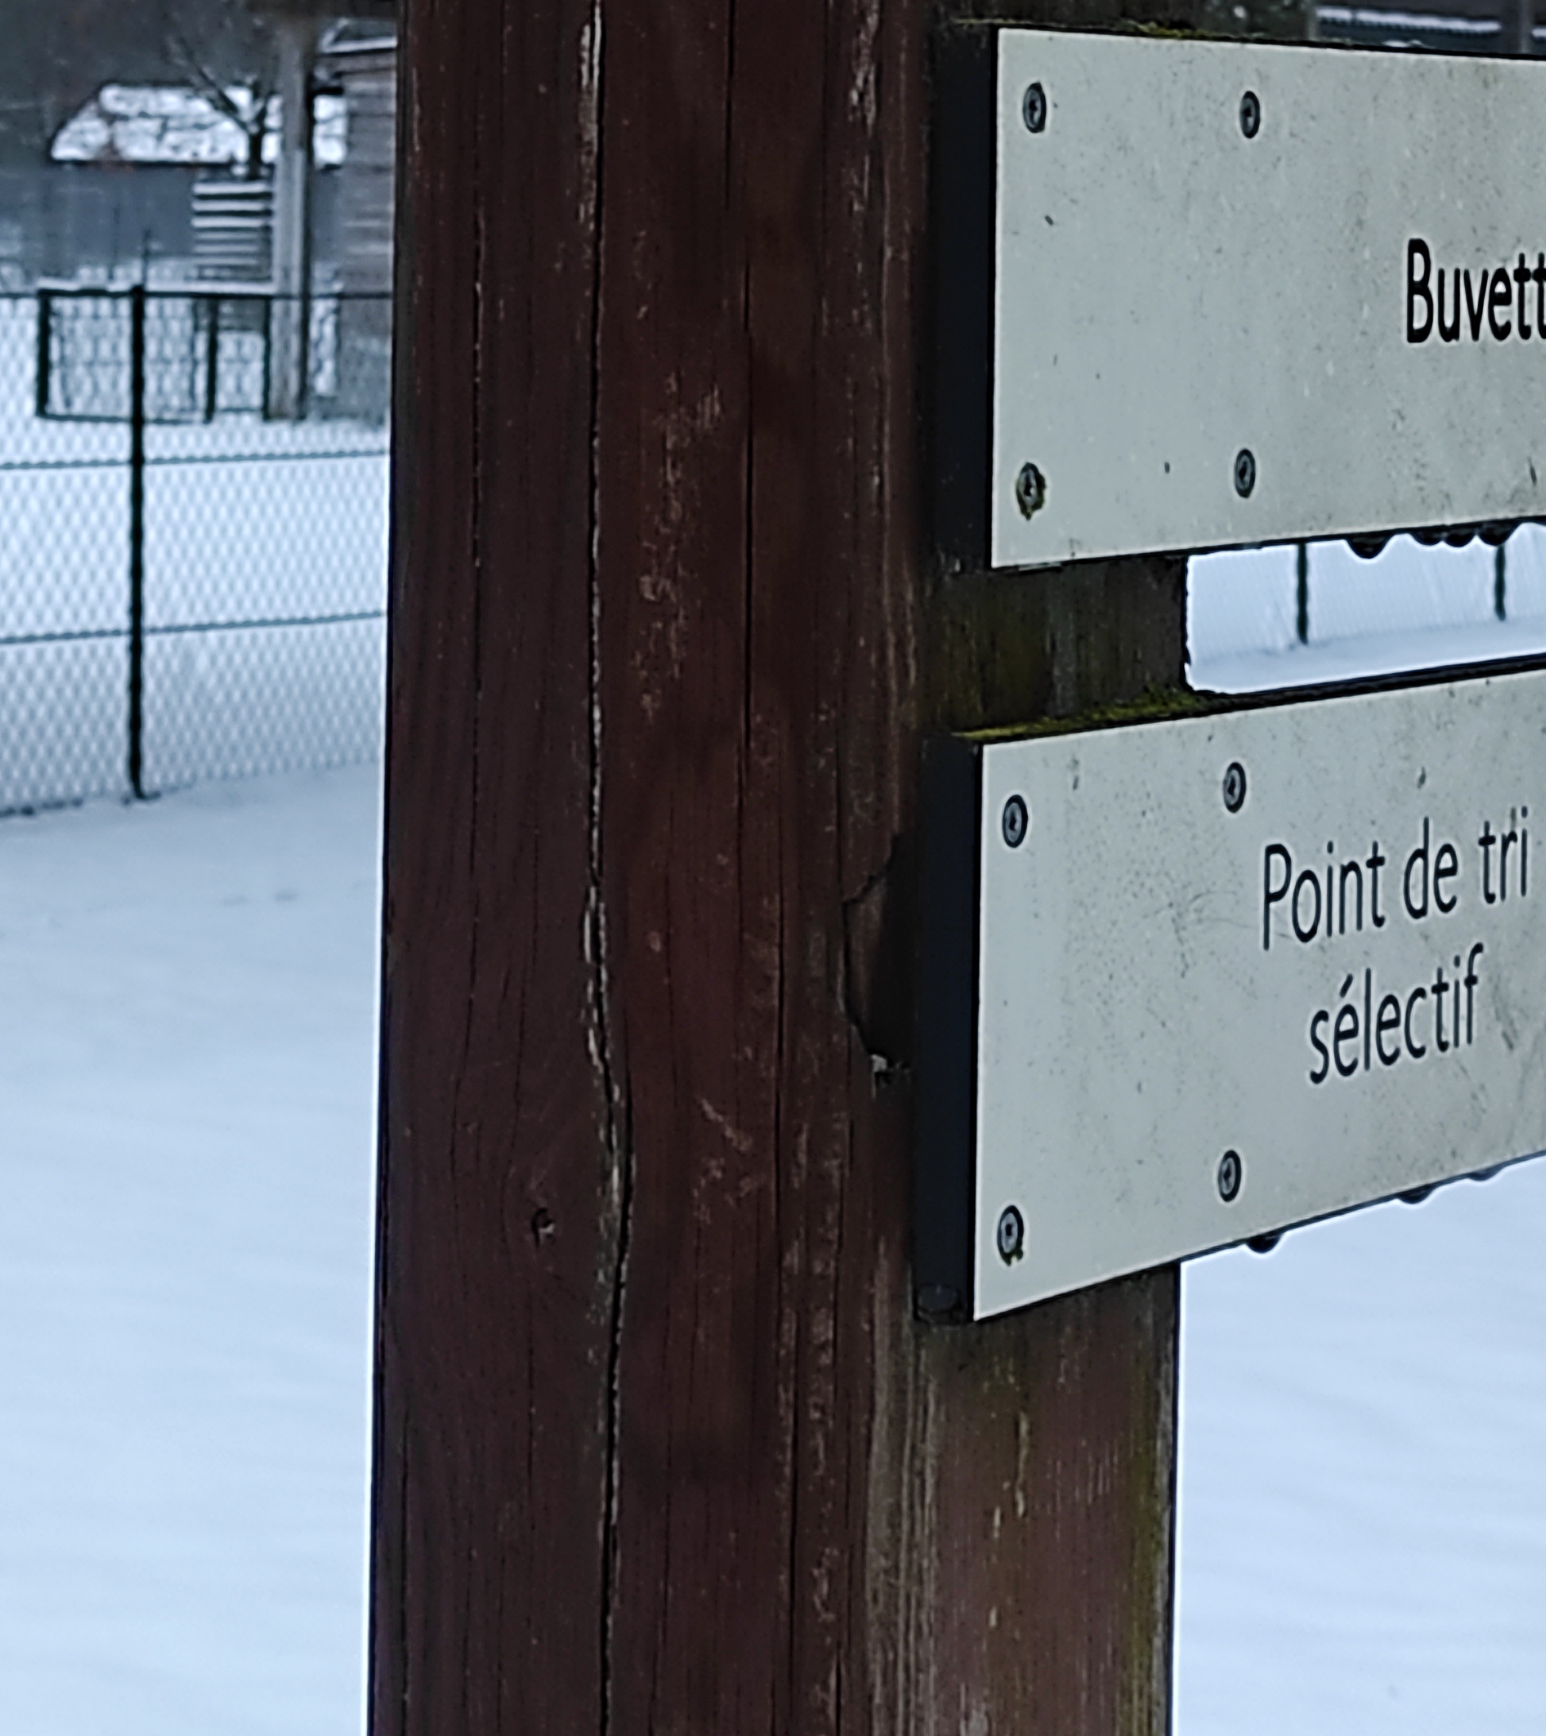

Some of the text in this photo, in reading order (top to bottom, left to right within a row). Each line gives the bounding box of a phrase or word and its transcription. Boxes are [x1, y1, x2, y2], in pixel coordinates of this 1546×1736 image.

[1264, 805, 1528, 951] Point de tri
[1309, 942, 1484, 1085] sélectif
